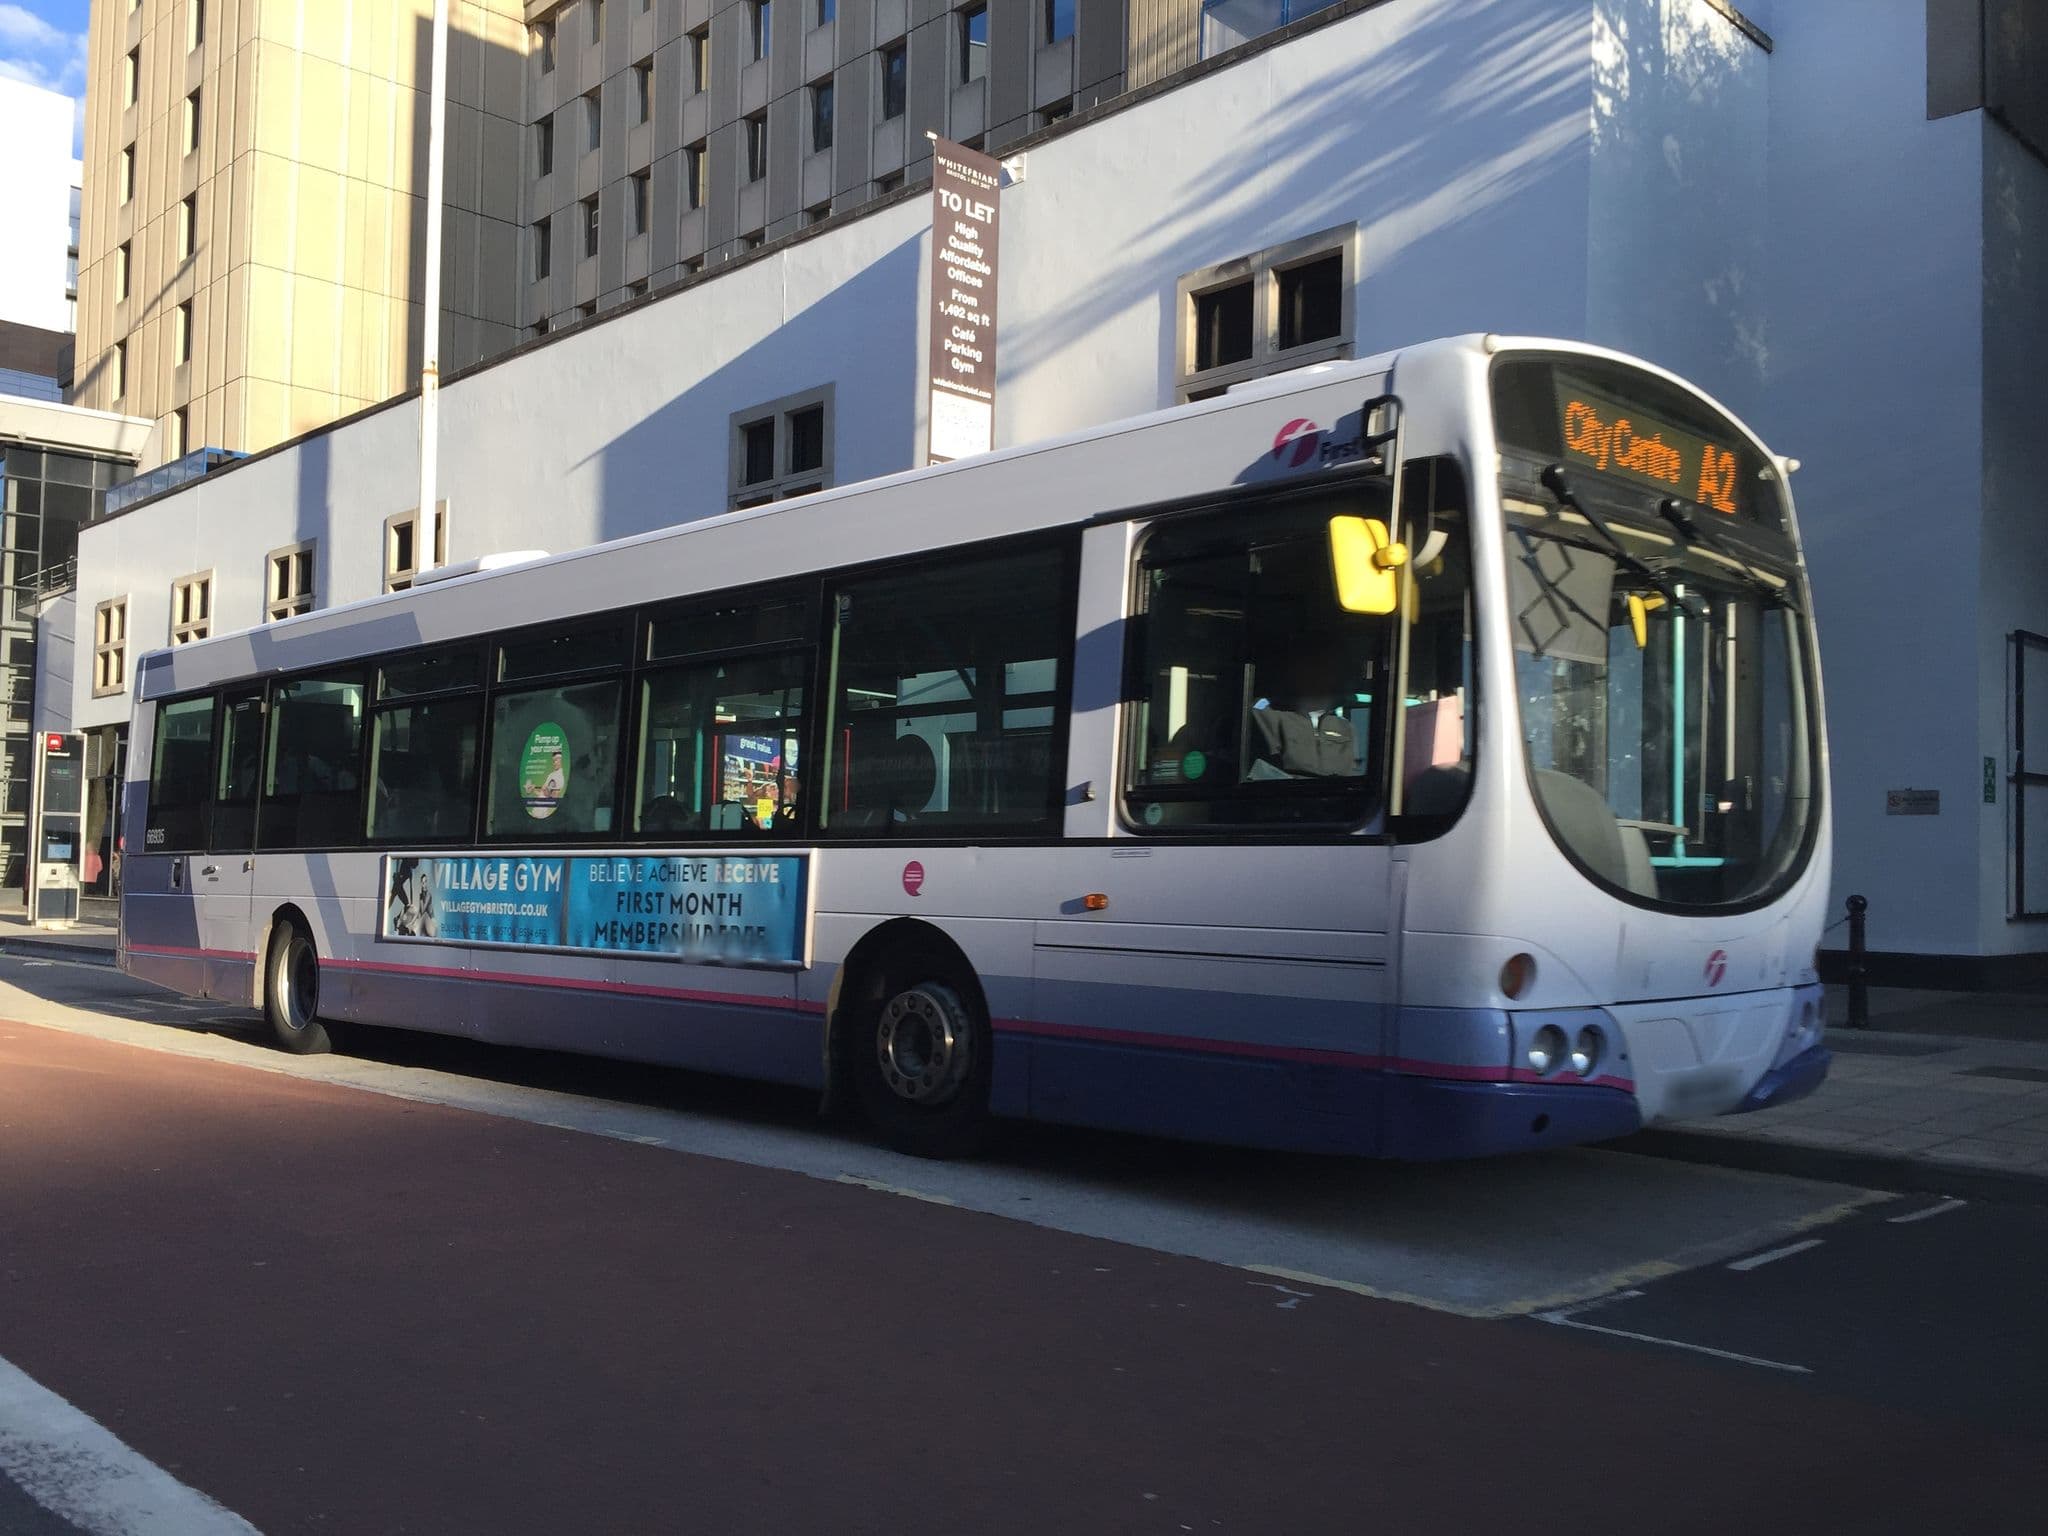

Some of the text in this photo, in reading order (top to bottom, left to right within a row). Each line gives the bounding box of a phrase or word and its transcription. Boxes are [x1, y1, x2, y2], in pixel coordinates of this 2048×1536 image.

[937, 155, 999, 187] WHITEFRIARS
[938, 187, 995, 224] TO LET
[954, 220, 978, 240] High
[948, 234, 984, 259] Quality
[939, 247, 991, 276] Affordable
[947, 266, 983, 289] Offices
[951, 288, 978, 307] From
[967, 311, 980, 326] sq
[981, 313, 991, 327] ft
[951, 325, 976, 342] Café
[944, 338, 983, 363] Parking
[951, 356, 975, 374] Gym
[1696, 443, 1736, 514] A2
[434, 863, 562, 892] VILLAGE GYM
[589, 863, 780, 884] BELIEVE ACHIEVE RECEIVE
[440, 900, 548, 917] VILLAGEGYMBRISTOL.CO.UK
[616, 891, 743, 917] FIRST MONTH
